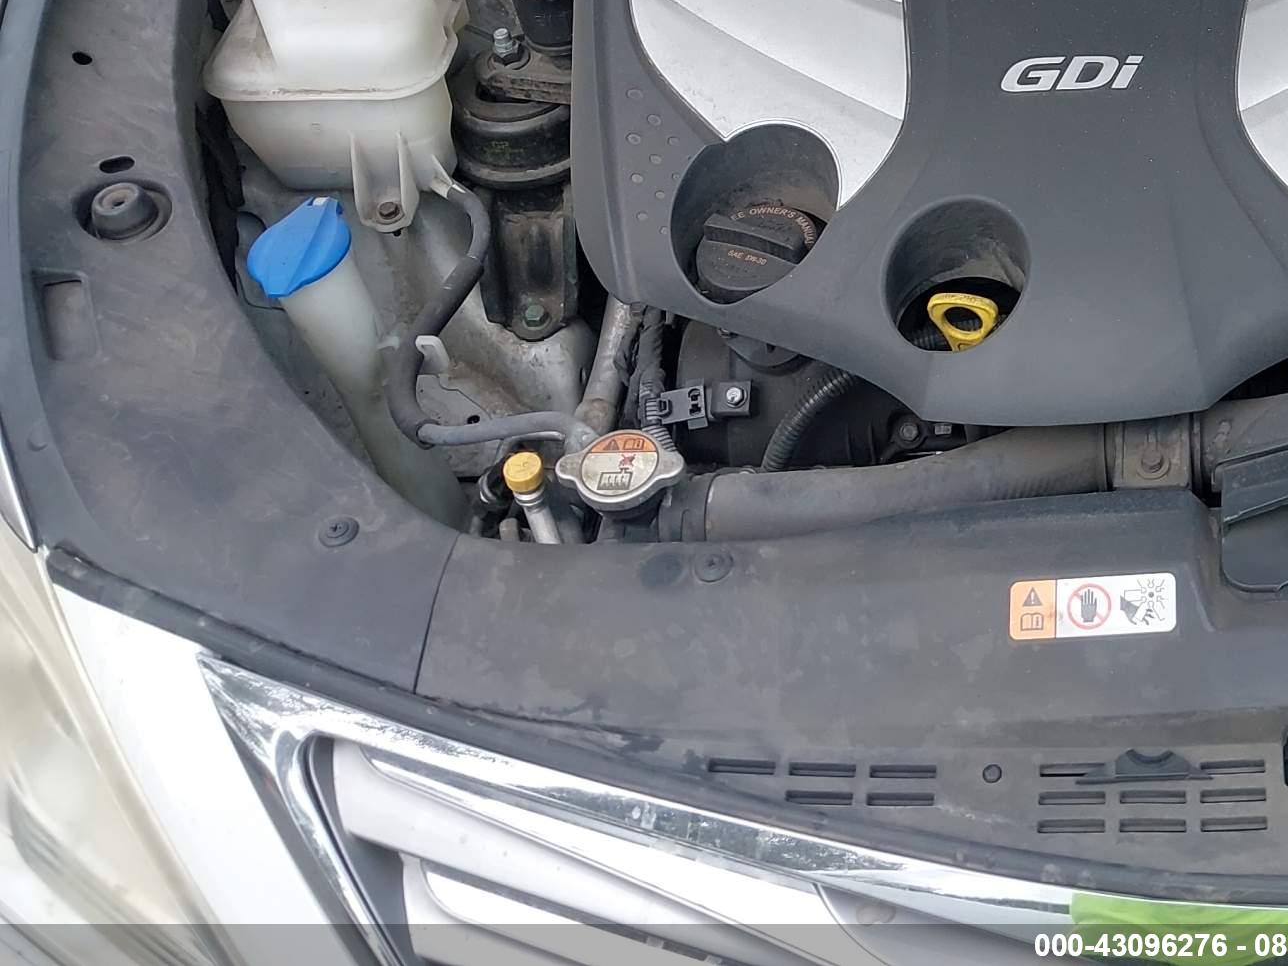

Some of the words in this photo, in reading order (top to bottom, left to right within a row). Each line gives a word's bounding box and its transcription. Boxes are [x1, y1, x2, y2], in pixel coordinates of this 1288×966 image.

[1001, 55, 1144, 92] GDi
[730, 211, 746, 221] EE
[749, 206, 797, 219] OWNER'S
